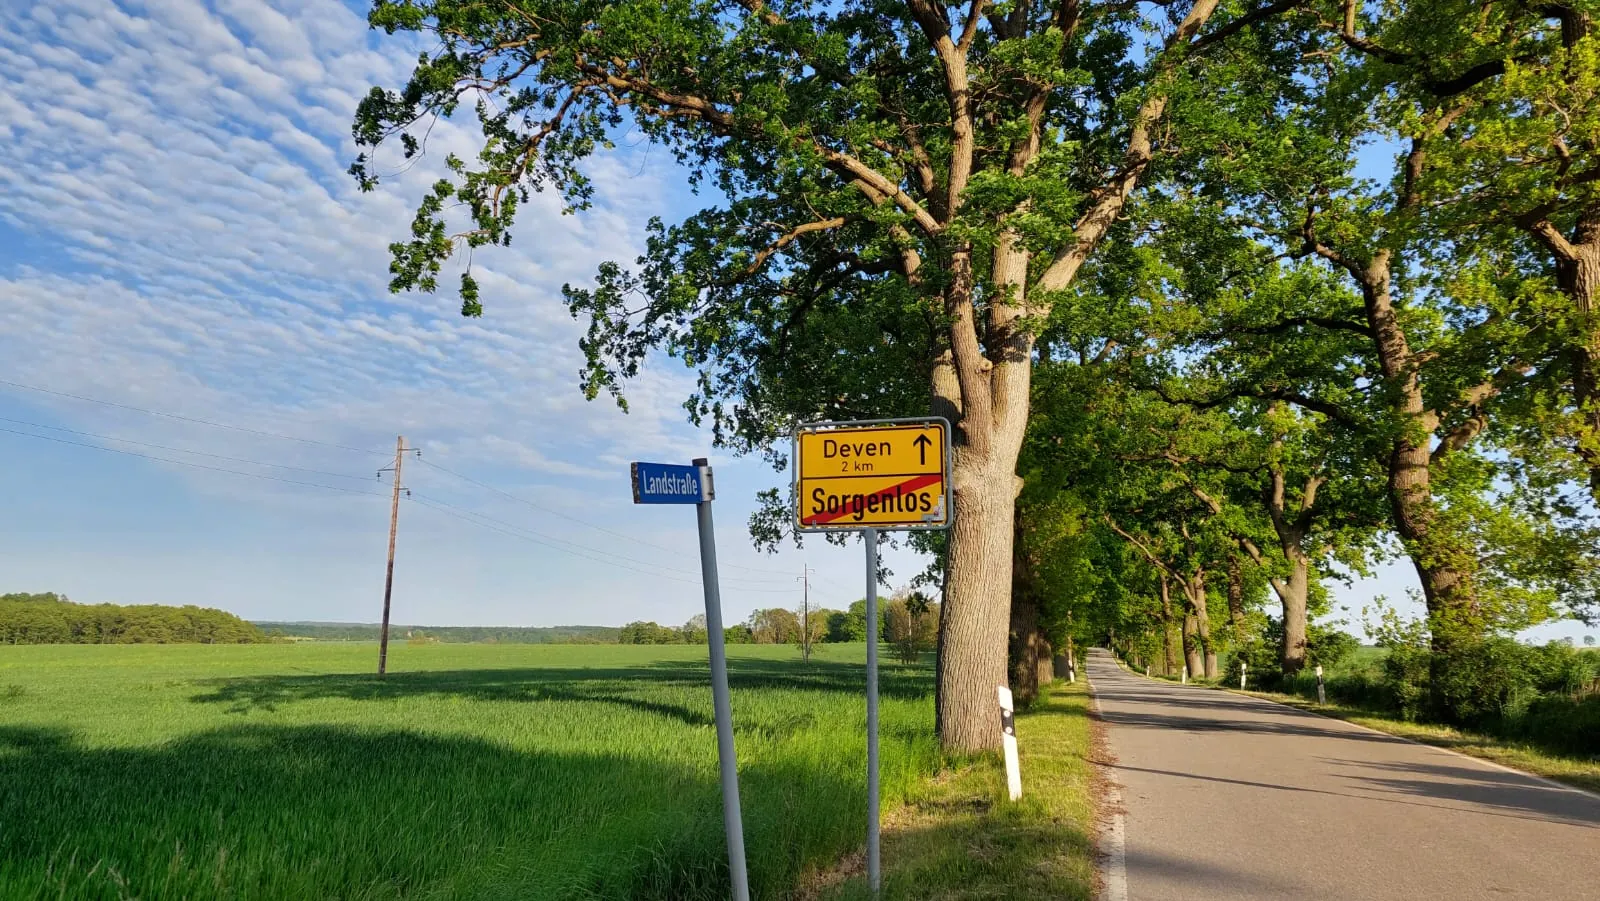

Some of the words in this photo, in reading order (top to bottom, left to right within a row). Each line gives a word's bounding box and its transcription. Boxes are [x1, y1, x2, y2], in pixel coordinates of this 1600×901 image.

[824, 439, 891, 458] Deven
[841, 461, 848, 472] 2
[854, 461, 874, 472] km
[643, 470, 698, 496] Landstraße
[812, 485, 932, 521] Sorgenlos
